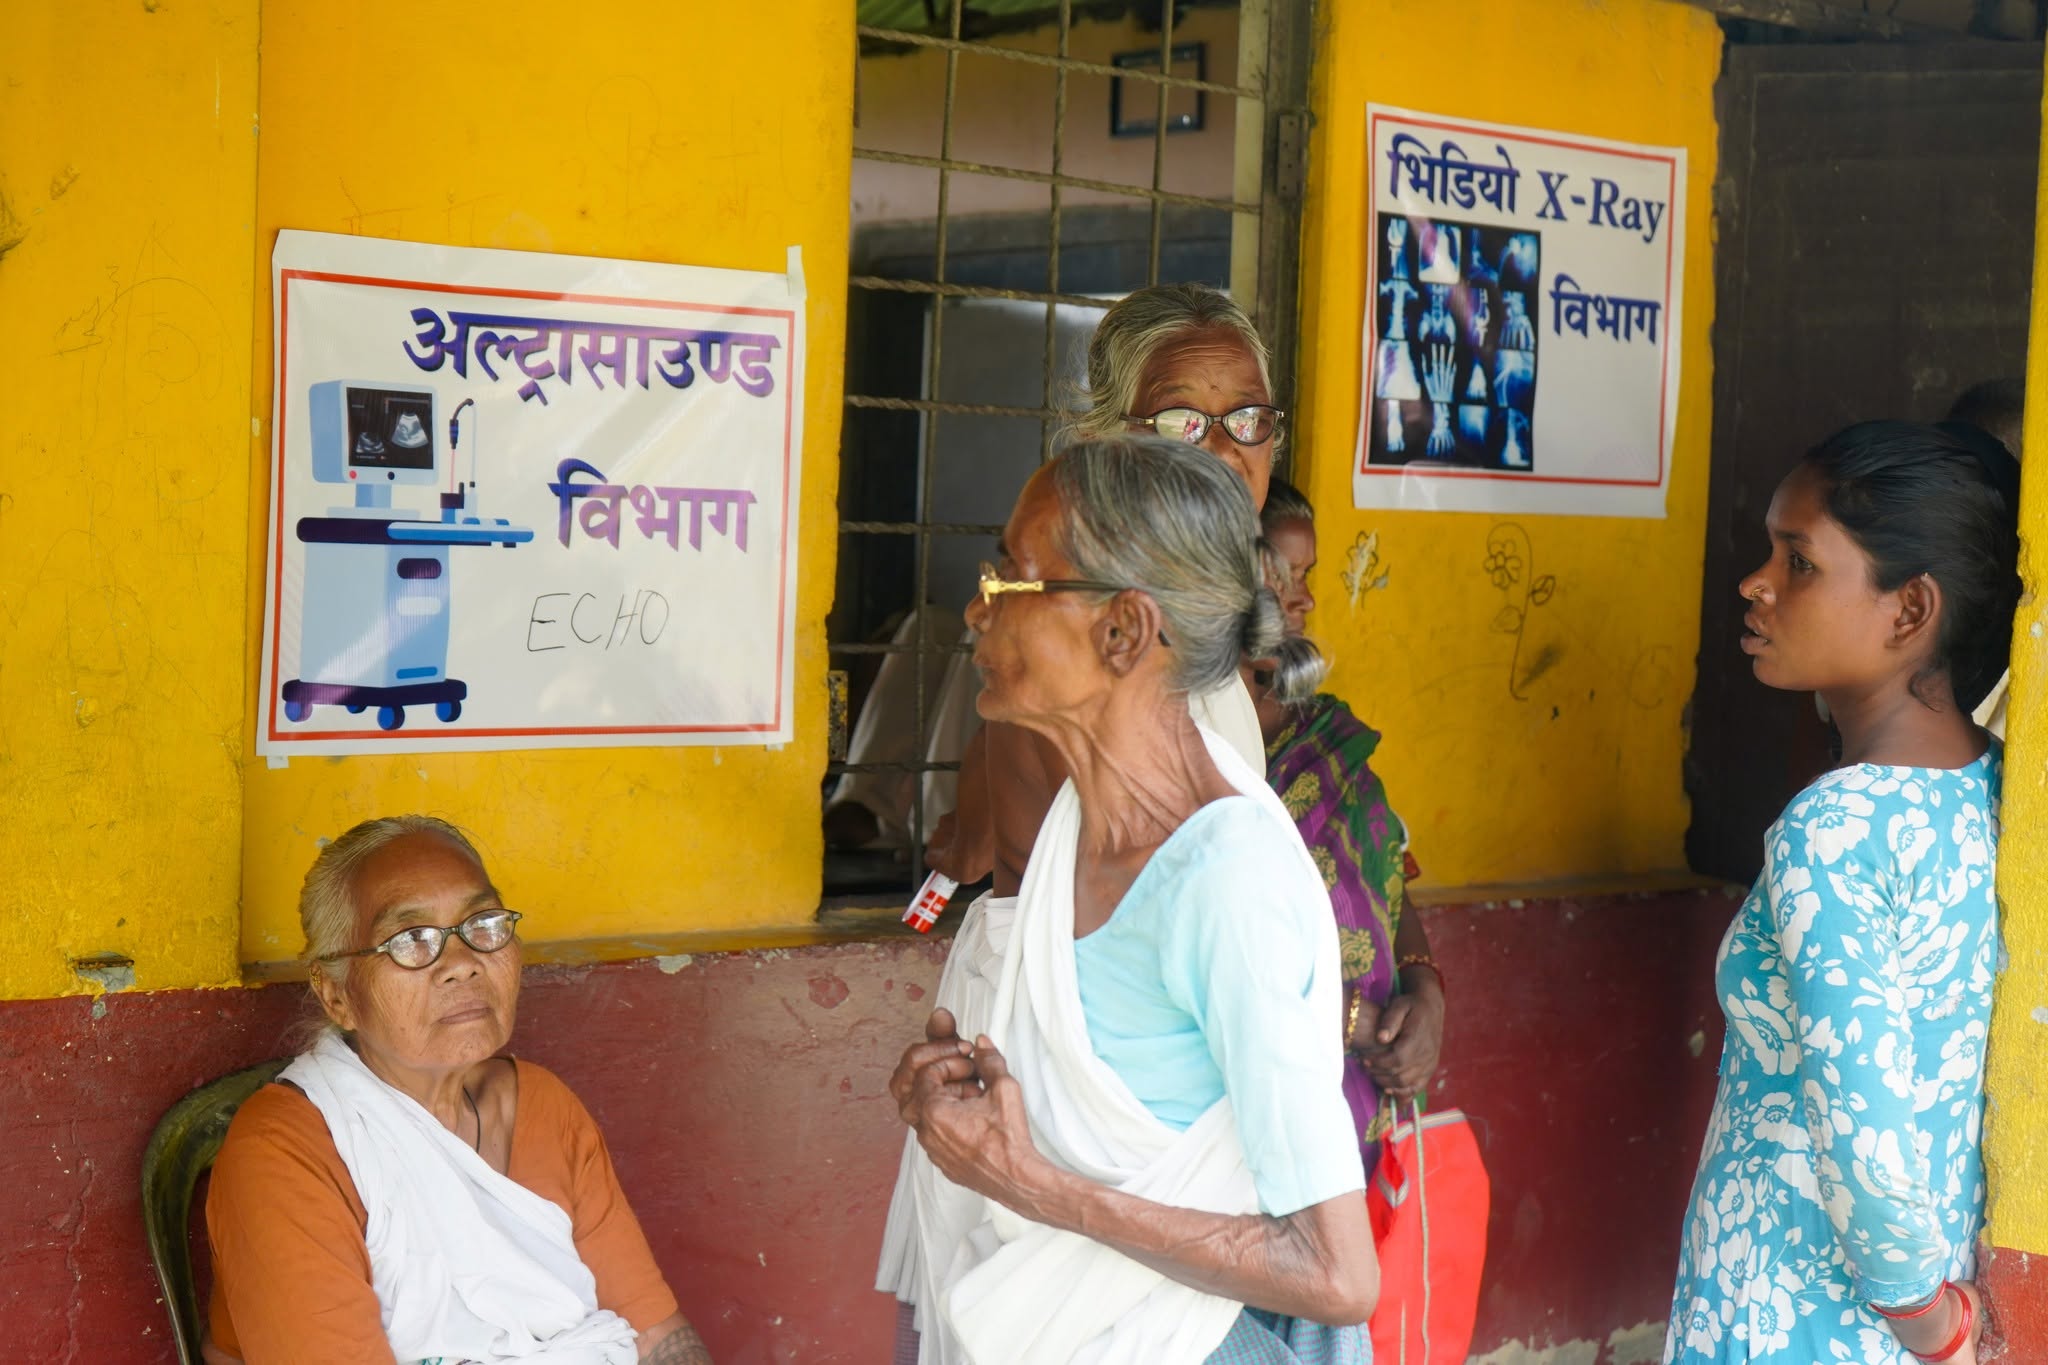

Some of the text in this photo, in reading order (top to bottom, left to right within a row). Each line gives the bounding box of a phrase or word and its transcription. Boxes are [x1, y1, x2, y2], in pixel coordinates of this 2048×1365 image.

[1386, 133, 1665, 243] भिडियो X-Ray
[1549, 272, 1661, 345] विभाग
[402, 307, 781, 406] अल्ट्रासाउण्ड
[547, 458, 757, 552] विभाग
[527, 589, 670, 652] ECHO
